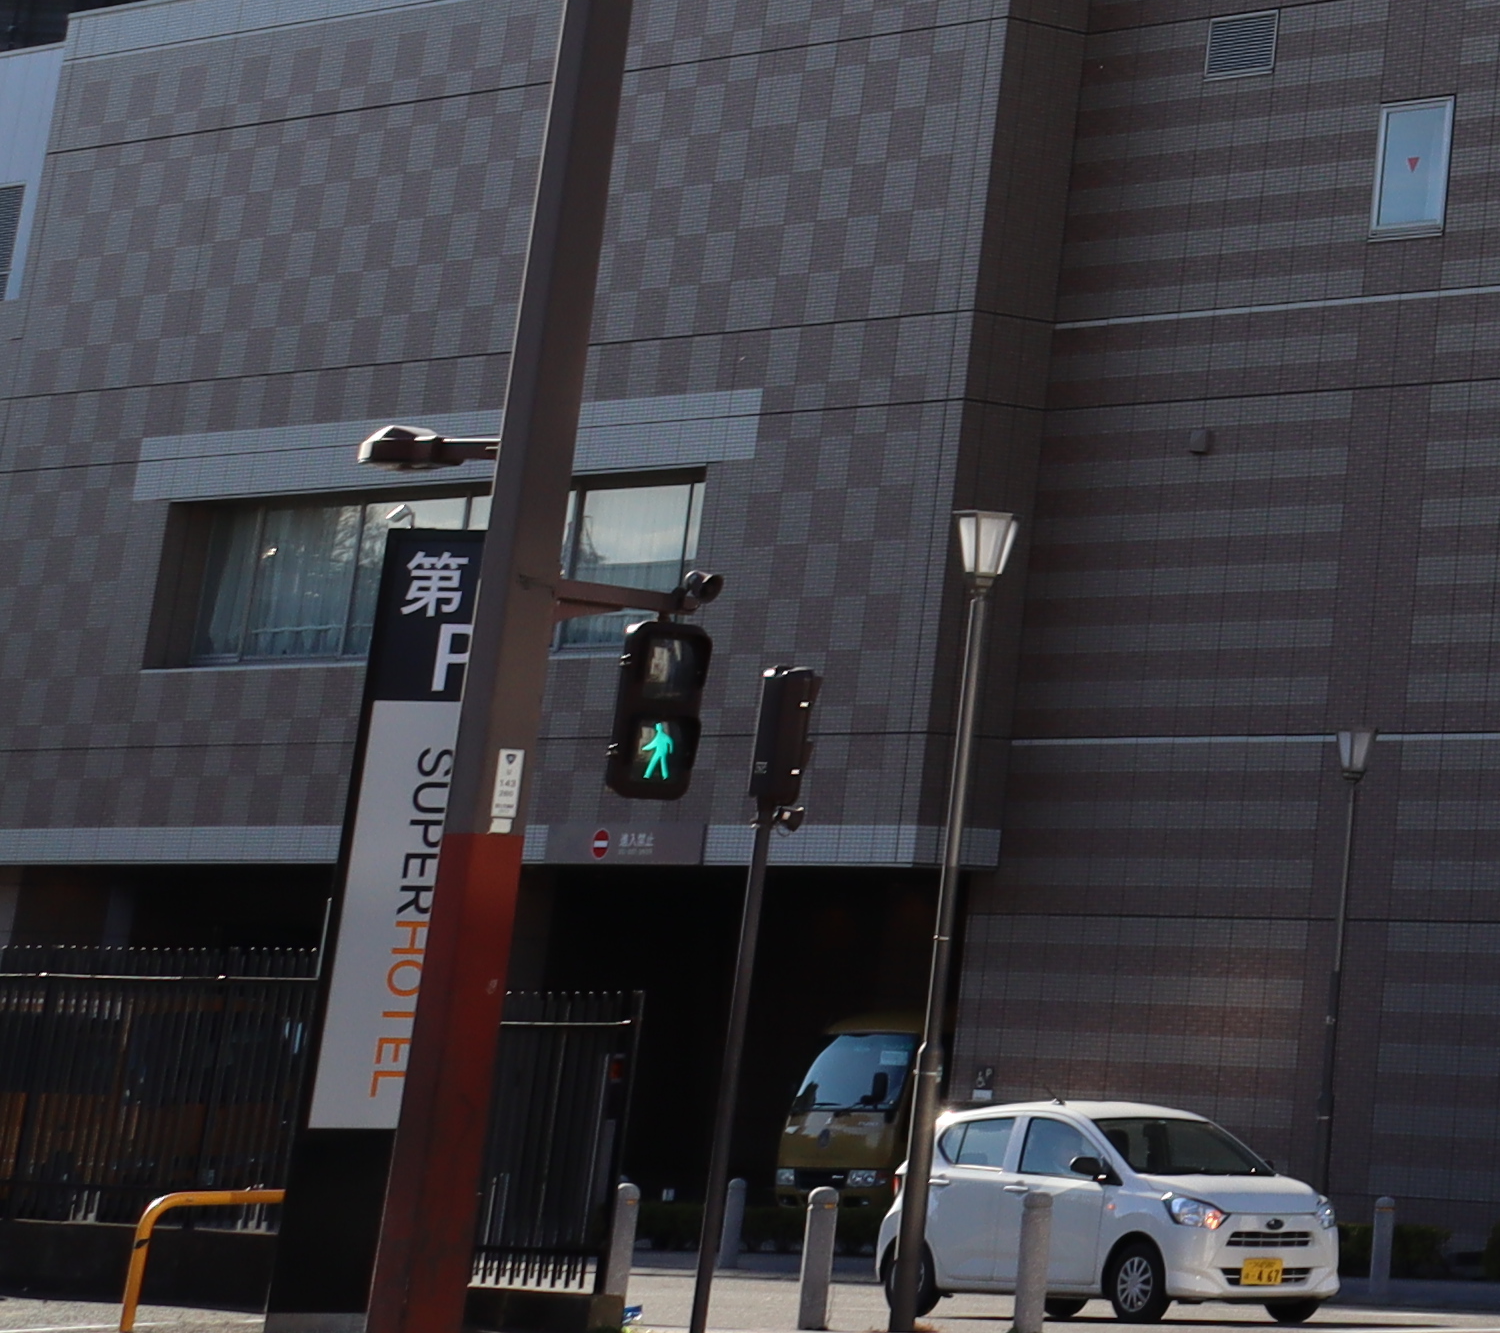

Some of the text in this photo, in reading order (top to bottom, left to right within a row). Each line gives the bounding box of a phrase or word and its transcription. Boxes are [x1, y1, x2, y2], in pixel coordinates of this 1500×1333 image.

[400, 551, 469, 617] 第
[431, 623, 473, 691] P
[396, 747, 454, 915] SUPER
